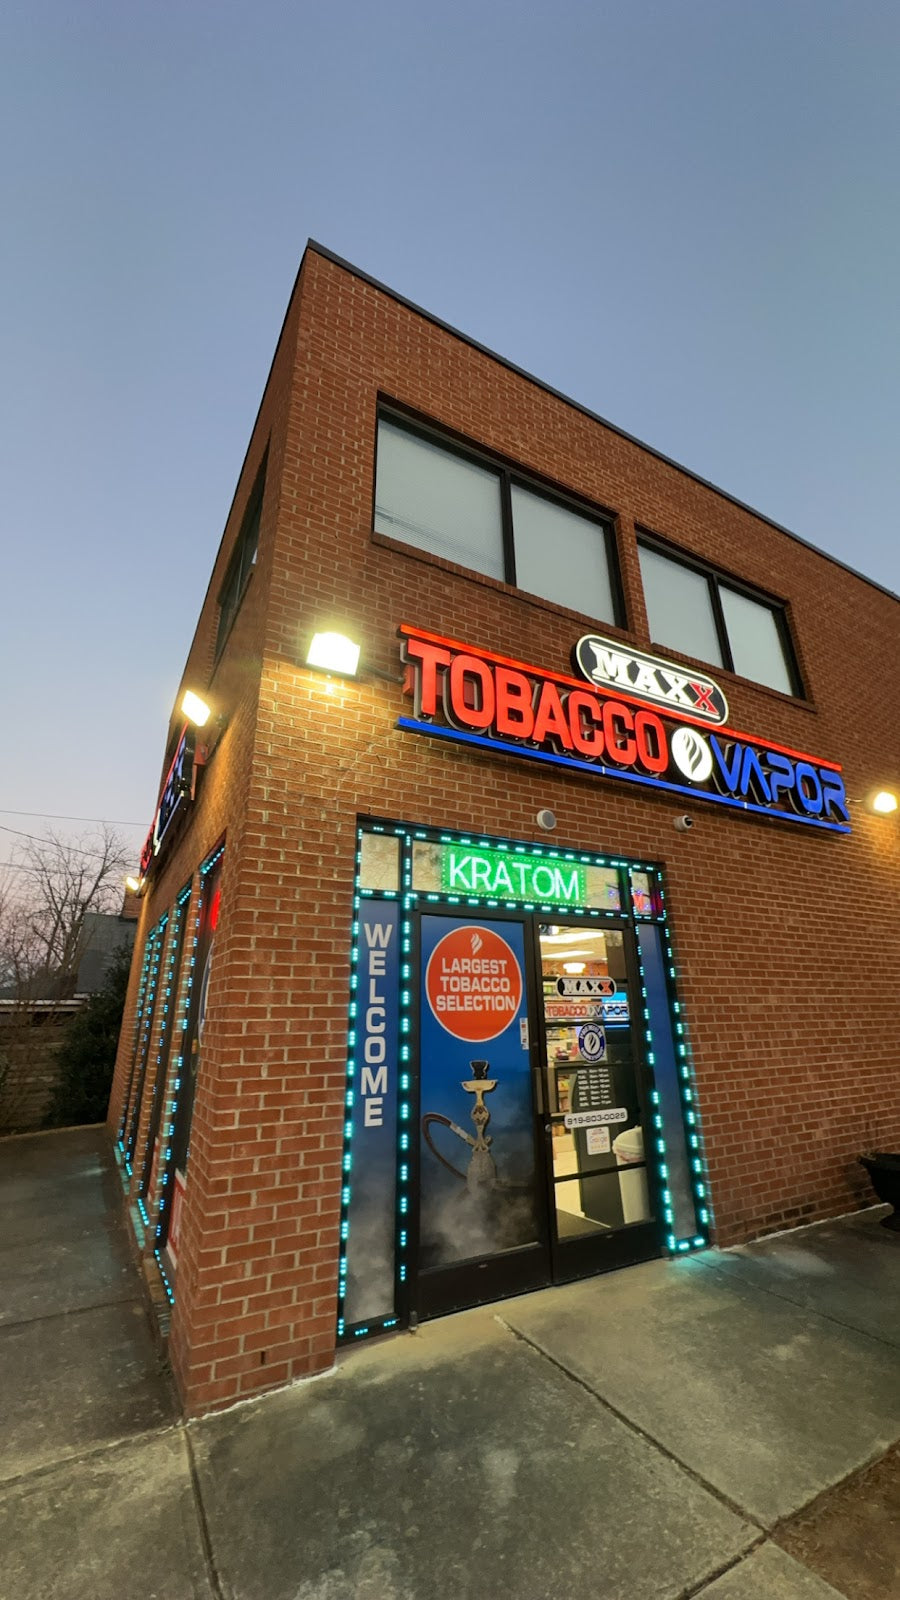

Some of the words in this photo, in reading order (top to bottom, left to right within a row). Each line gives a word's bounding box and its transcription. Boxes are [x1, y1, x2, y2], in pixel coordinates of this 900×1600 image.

[588, 640, 720, 720] MAXX
[407, 638, 669, 773] TOBACCO
[709, 733, 850, 822] VAPOR
[449, 853, 580, 901] KRATOM
[441, 957, 508, 975] LARGEST
[439, 975, 511, 993] TOBACCO
[562, 978, 613, 996] MAXX
[436, 994, 516, 1012] SELECTION
[546, 1005, 588, 1017] TOBACCO
[360, 922, 393, 1128] WELCOME
